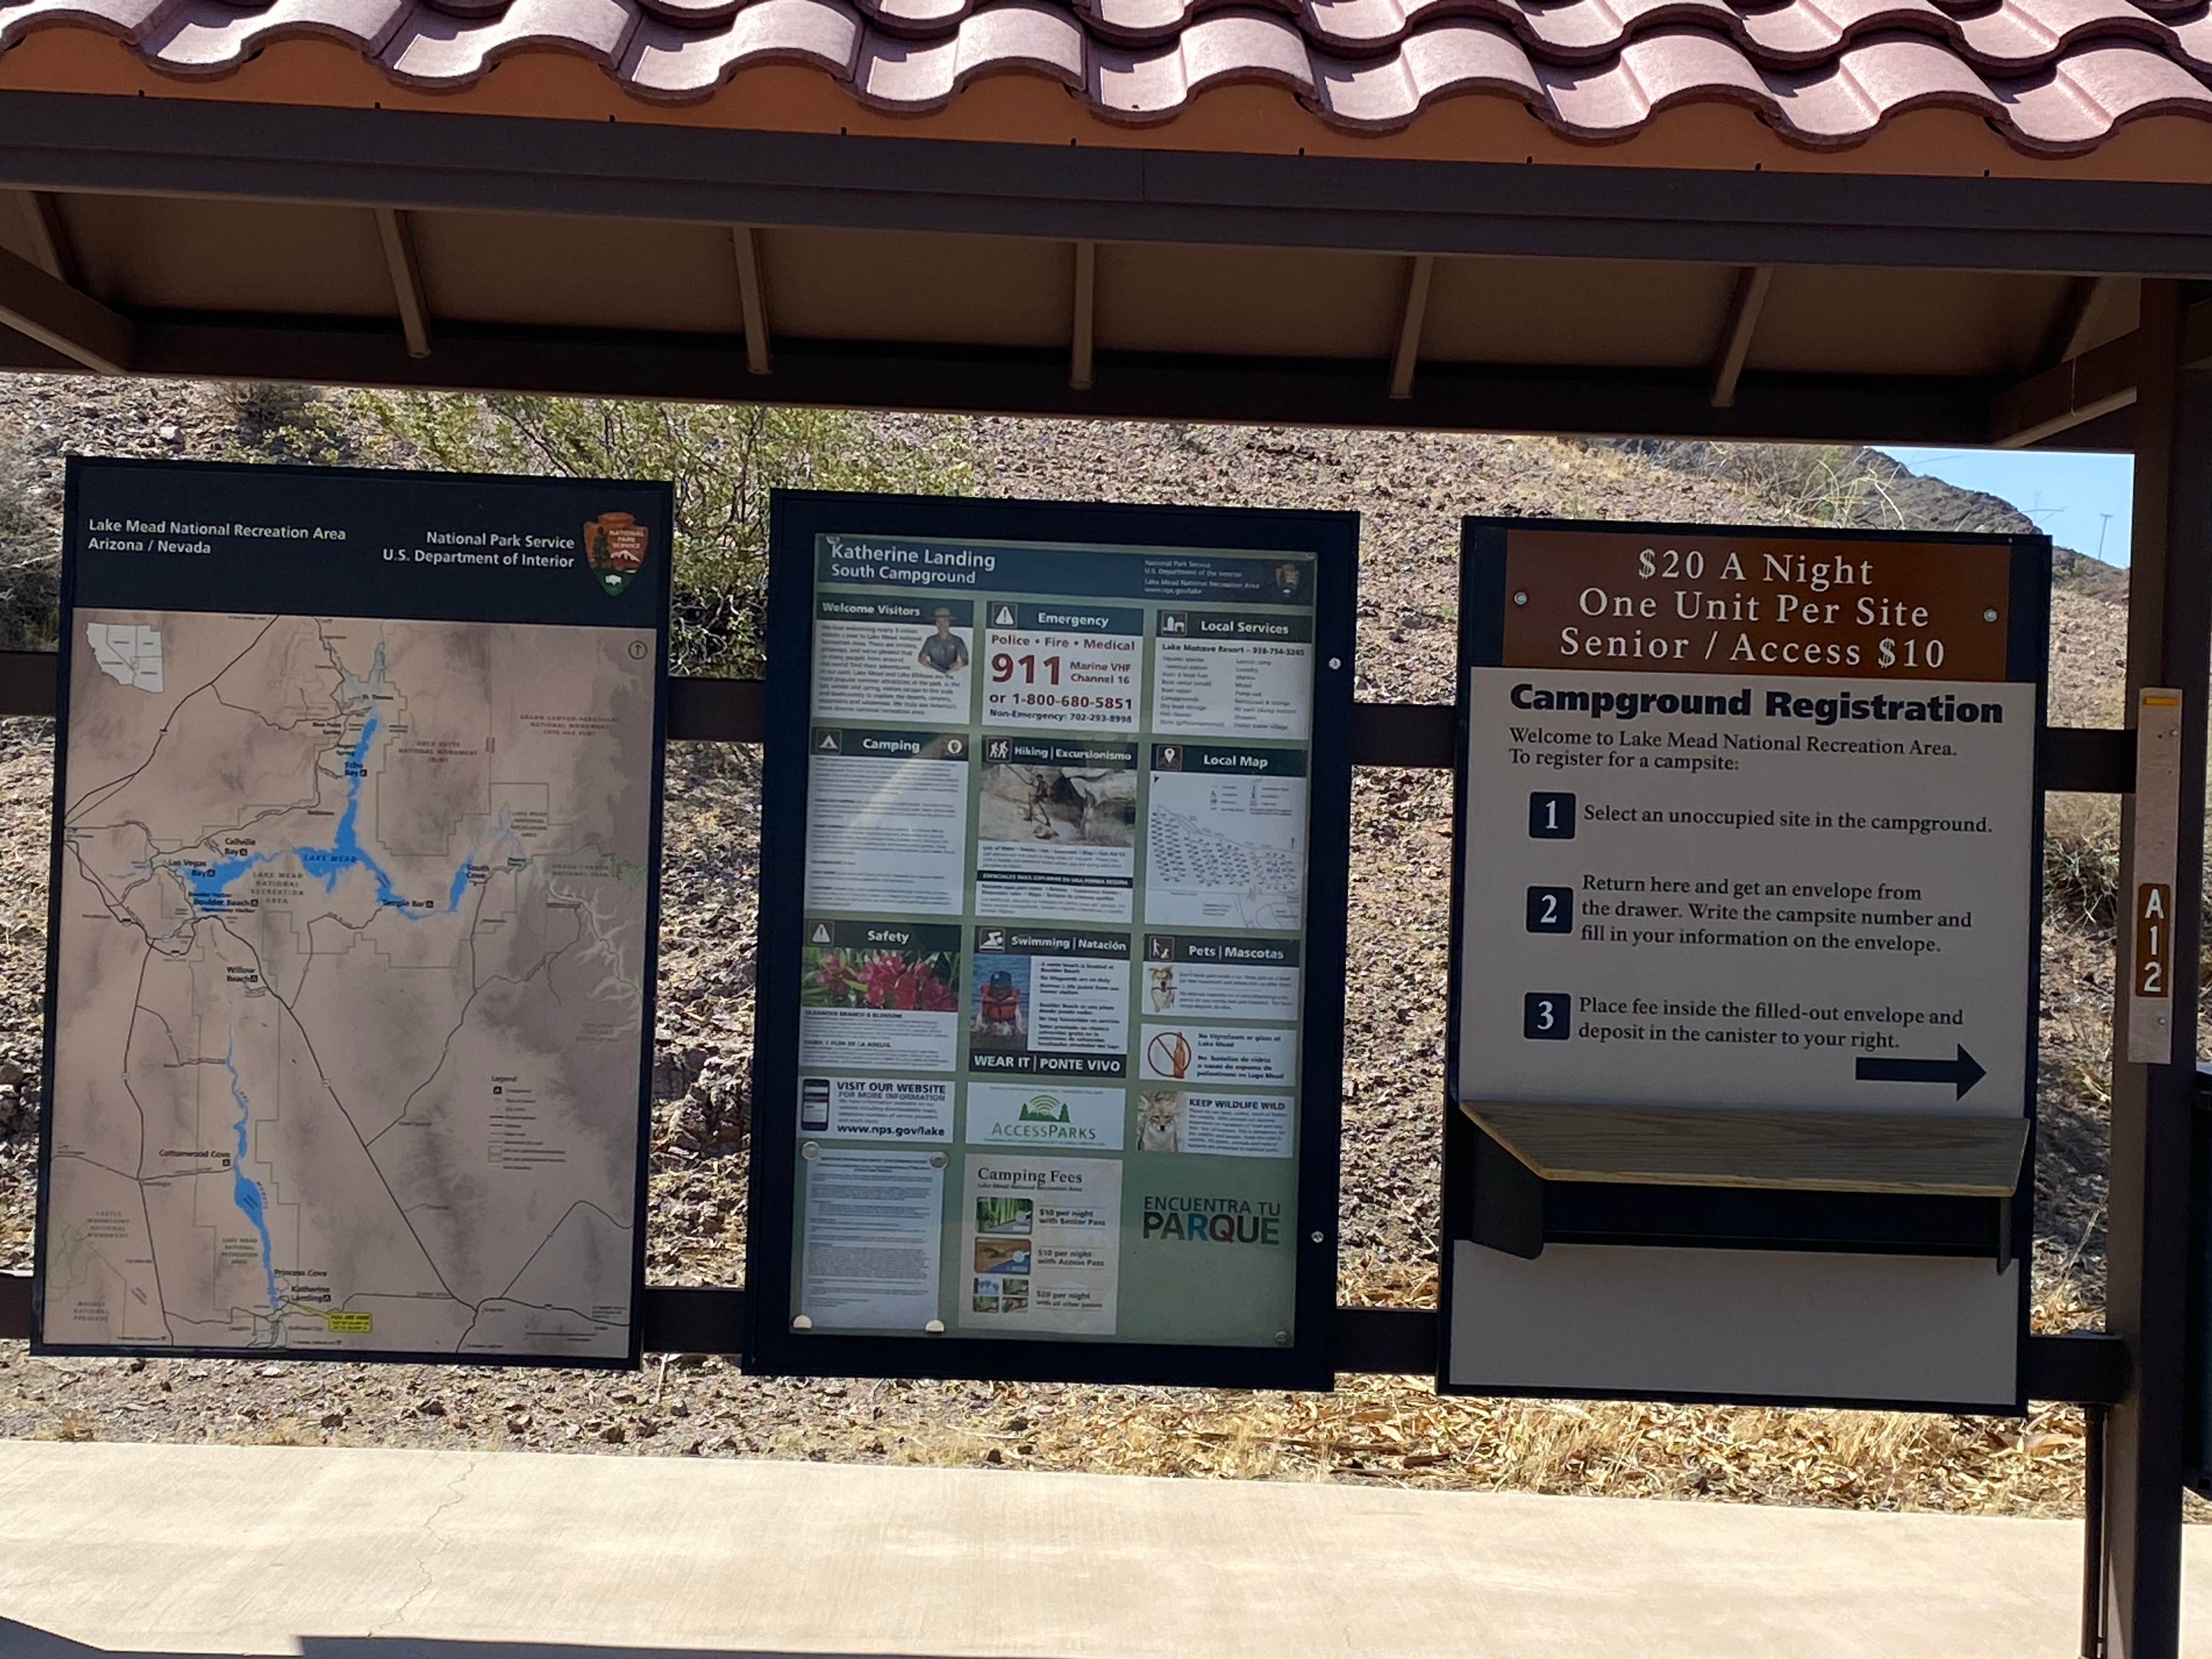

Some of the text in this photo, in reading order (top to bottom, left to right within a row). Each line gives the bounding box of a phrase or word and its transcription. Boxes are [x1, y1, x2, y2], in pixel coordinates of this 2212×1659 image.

[89, 518, 346, 540] Lake Mead National Recreation Area
[88, 537, 143, 551] Arizona
[158, 540, 211, 554] Nevada
[427, 531, 574, 549] National Park Service
[383, 548, 574, 567] U.S. Department of Interior
[832, 544, 996, 571] Katherine Landing
[831, 563, 976, 584] South Campground
[1639, 548, 1873, 591] $20 A Night
[823, 602, 921, 616] Welcome Visitors
[1579, 588, 1928, 627] One Unit Per Site
[1038, 612, 1109, 628] Emergency
[1201, 620, 1289, 634] Local Services
[991, 635, 1135, 651] Police Fire Medical
[1561, 627, 1689, 658] Senior
[1730, 633, 1860, 665] Access
[1878, 637, 1944, 668] $10
[991, 653, 1060, 685] 911
[1070, 662, 1131, 672] Marine VHF
[1071, 673, 1130, 684] Channel 16
[990, 693, 1132, 710] or 1-800-680-5851
[1510, 684, 2003, 726] Campground Registration
[862, 738, 920, 754] Camping
[1509, 727, 1957, 756] Welcome to Lake Mead National Recreation Area.
[1014, 746, 1132, 761] Hiking Excursionismo
[1203, 754, 1268, 770] Local Map
[1508, 748, 1739, 774] To register for a campsite:
[1544, 800, 1559, 830] 1
[1584, 804, 1992, 835] Select an unoccupied site in the campground.
[1582, 874, 1921, 903] Return here and get an envelope from
[1539, 895, 1558, 924] 2
[1582, 899, 1972, 928] the drawer. Write the campsite number and
[867, 930, 910, 945] Safety
[1011, 935, 1127, 951] Swimming Natación
[1581, 924, 1940, 956] fill in your information on the envelope.
[1189, 945, 1284, 960] Pets Mascotas
[1537, 1001, 1554, 1030] 3
[1579, 996, 1963, 1026] Place fee inside the filled-out envelope and
[1578, 1022, 1899, 1052] deposit in the canister to your right.
[974, 1055, 1121, 1071] WEAR IT PONTE VIVO
[837, 1081, 946, 1094] VISIT OUR WEBSITE
[1189, 1098, 1285, 1110] KEEP WILDLIFE WILD
[837, 1125, 945, 1136] www.nps.gov/lake
[978, 1167, 1082, 1185] Camping Fees
[1144, 1195, 1280, 1216] ENCUENTRA TU
[1143, 1211, 1280, 1245] PARQUE
